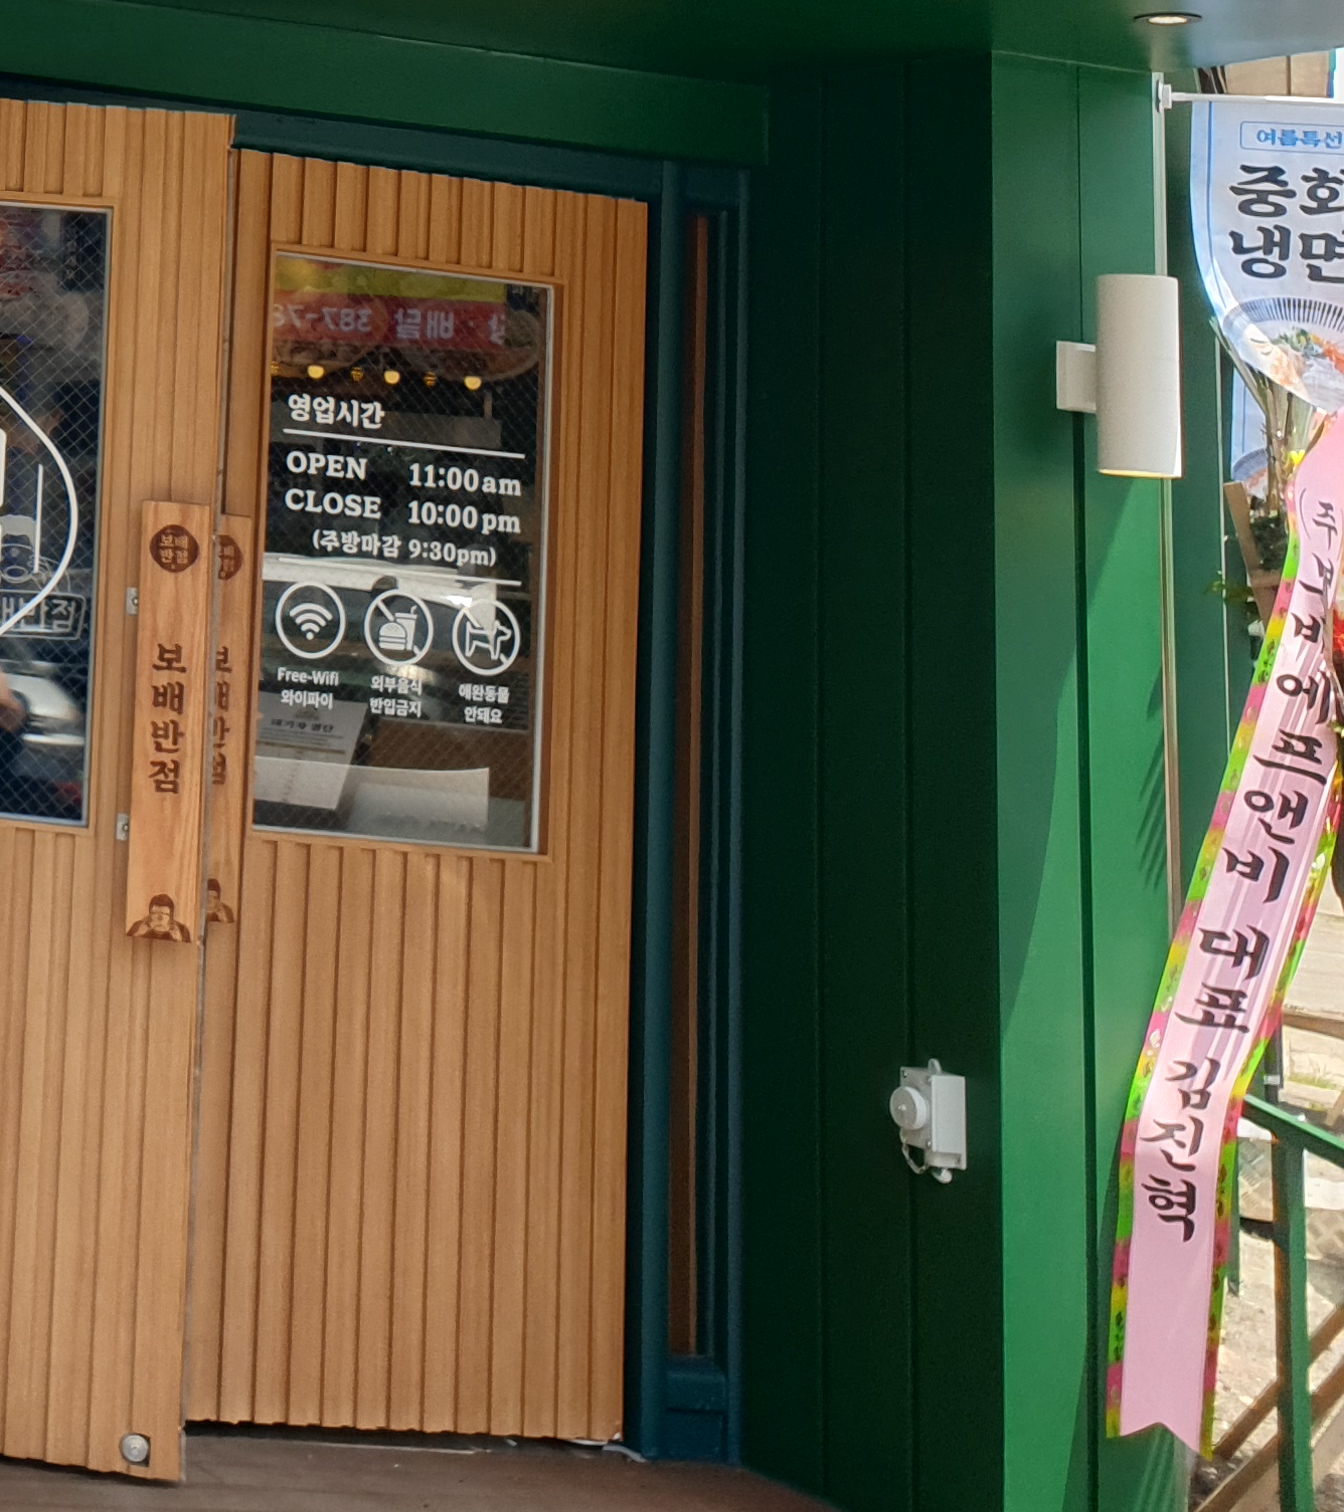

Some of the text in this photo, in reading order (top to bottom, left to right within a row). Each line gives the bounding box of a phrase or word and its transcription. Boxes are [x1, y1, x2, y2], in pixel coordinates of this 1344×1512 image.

[287, 394, 384, 429] 영업시간
[286, 451, 522, 497] OPEN 11:00 am
[284, 488, 522, 535] CLOSE 10:00 pm
[312, 528, 497, 568] (주방마감 9:30pm)
[277, 667, 339, 687] Free-Wifi
[370, 675, 423, 696] 외부음식
[280, 689, 334, 710] 와이파이
[369, 697, 422, 719] 반입금지
[147, 642, 188, 795] 보배반점
